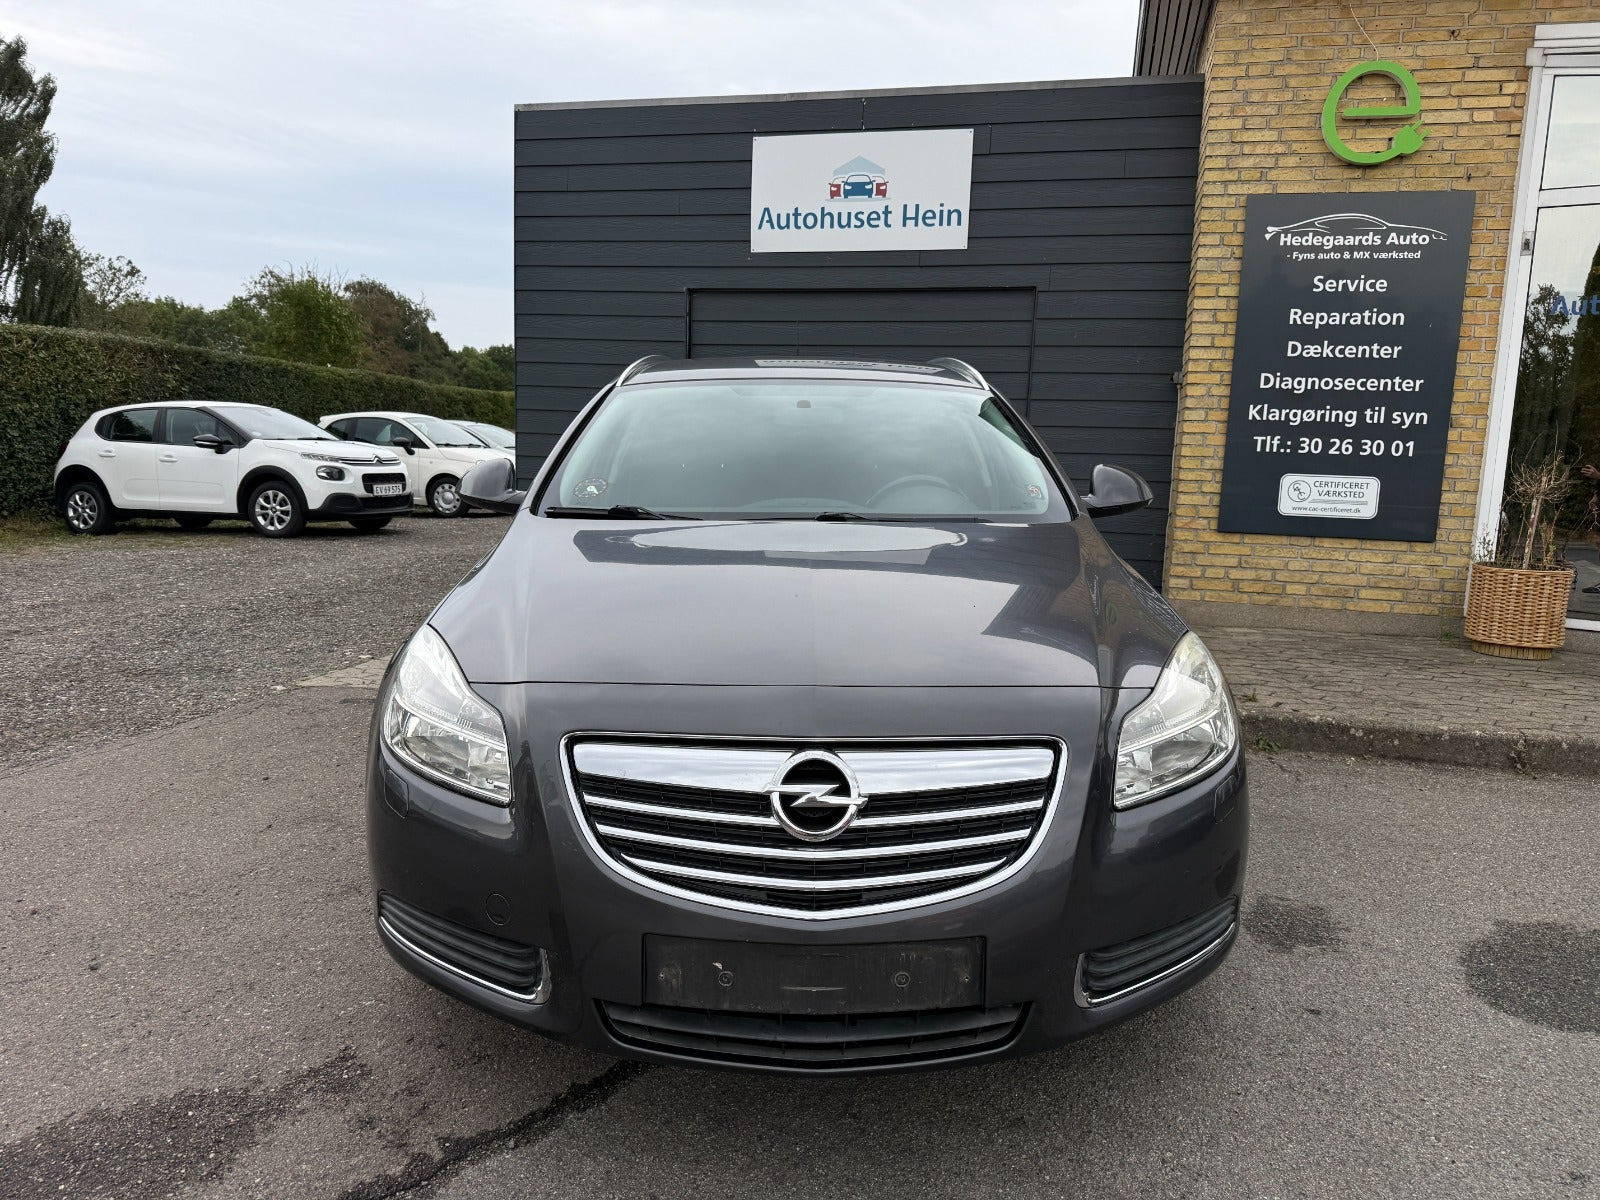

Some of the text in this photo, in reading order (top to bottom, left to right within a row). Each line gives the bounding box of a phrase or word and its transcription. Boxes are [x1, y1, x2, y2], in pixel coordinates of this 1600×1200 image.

[757, 203, 962, 230] Autohuset Hein
[1279, 232, 1430, 249] Hedegaards Auto
[1292, 251, 1316, 262] Fyns
[1317, 252, 1341, 260] auto
[1343, 251, 1350, 259] &
[1353, 251, 1371, 259] MX
[1373, 250, 1421, 259] værksted
[1312, 275, 1388, 293] Service
[1289, 308, 1405, 329] Reparation
[1286, 340, 1402, 359] Dækcenter
[1259, 372, 1424, 394] Diagnosecenter
[1248, 404, 1428, 429] Klargøring til syn
[1253, 436, 1415, 457] Tlf.: 30 26 30 01
[1313, 480, 1370, 490] CERTIFICERET
[1317, 489, 1365, 499] VÆRKSTED
[1292, 505, 1361, 514] www.cac-certificeret.dk
